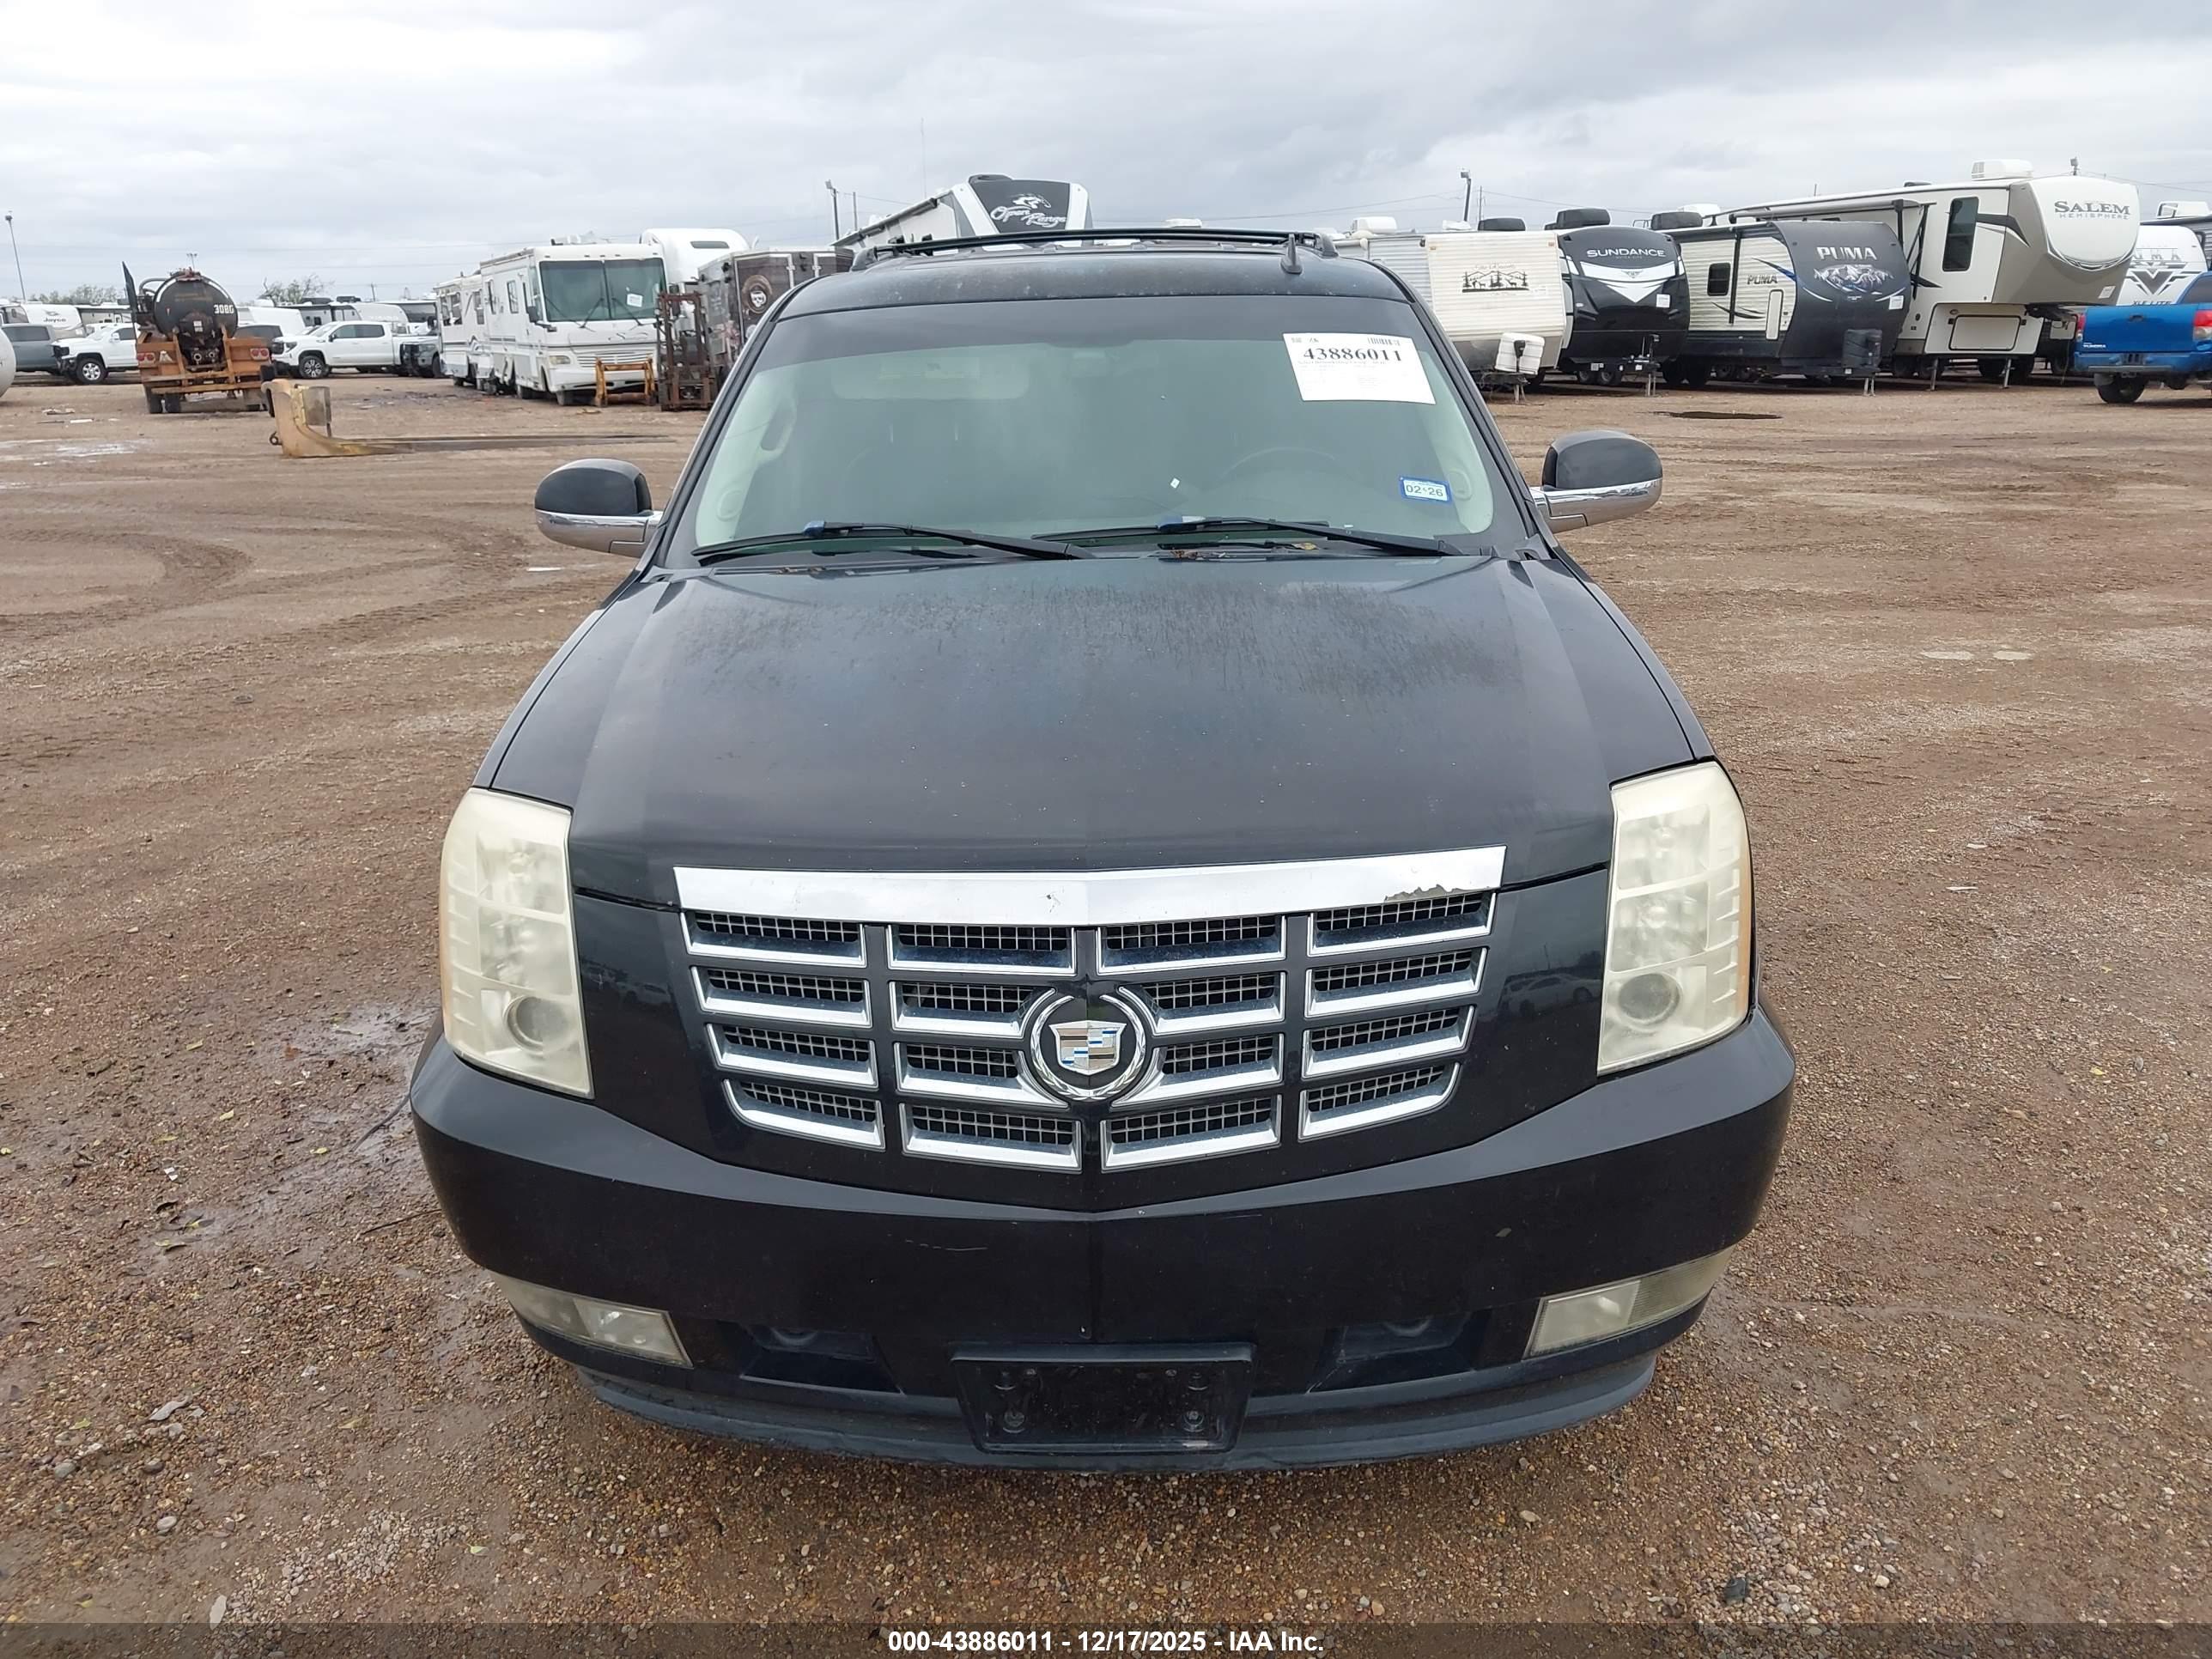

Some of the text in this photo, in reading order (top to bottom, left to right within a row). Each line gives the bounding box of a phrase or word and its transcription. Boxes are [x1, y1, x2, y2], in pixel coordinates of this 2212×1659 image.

[990, 206, 1066, 228] Open Range
[1586, 248, 1667, 258] SUNDANCE
[1816, 246, 1878, 260] PUMA
[1747, 275, 1778, 285] PUMA
[1304, 348, 1402, 362] 43886011
